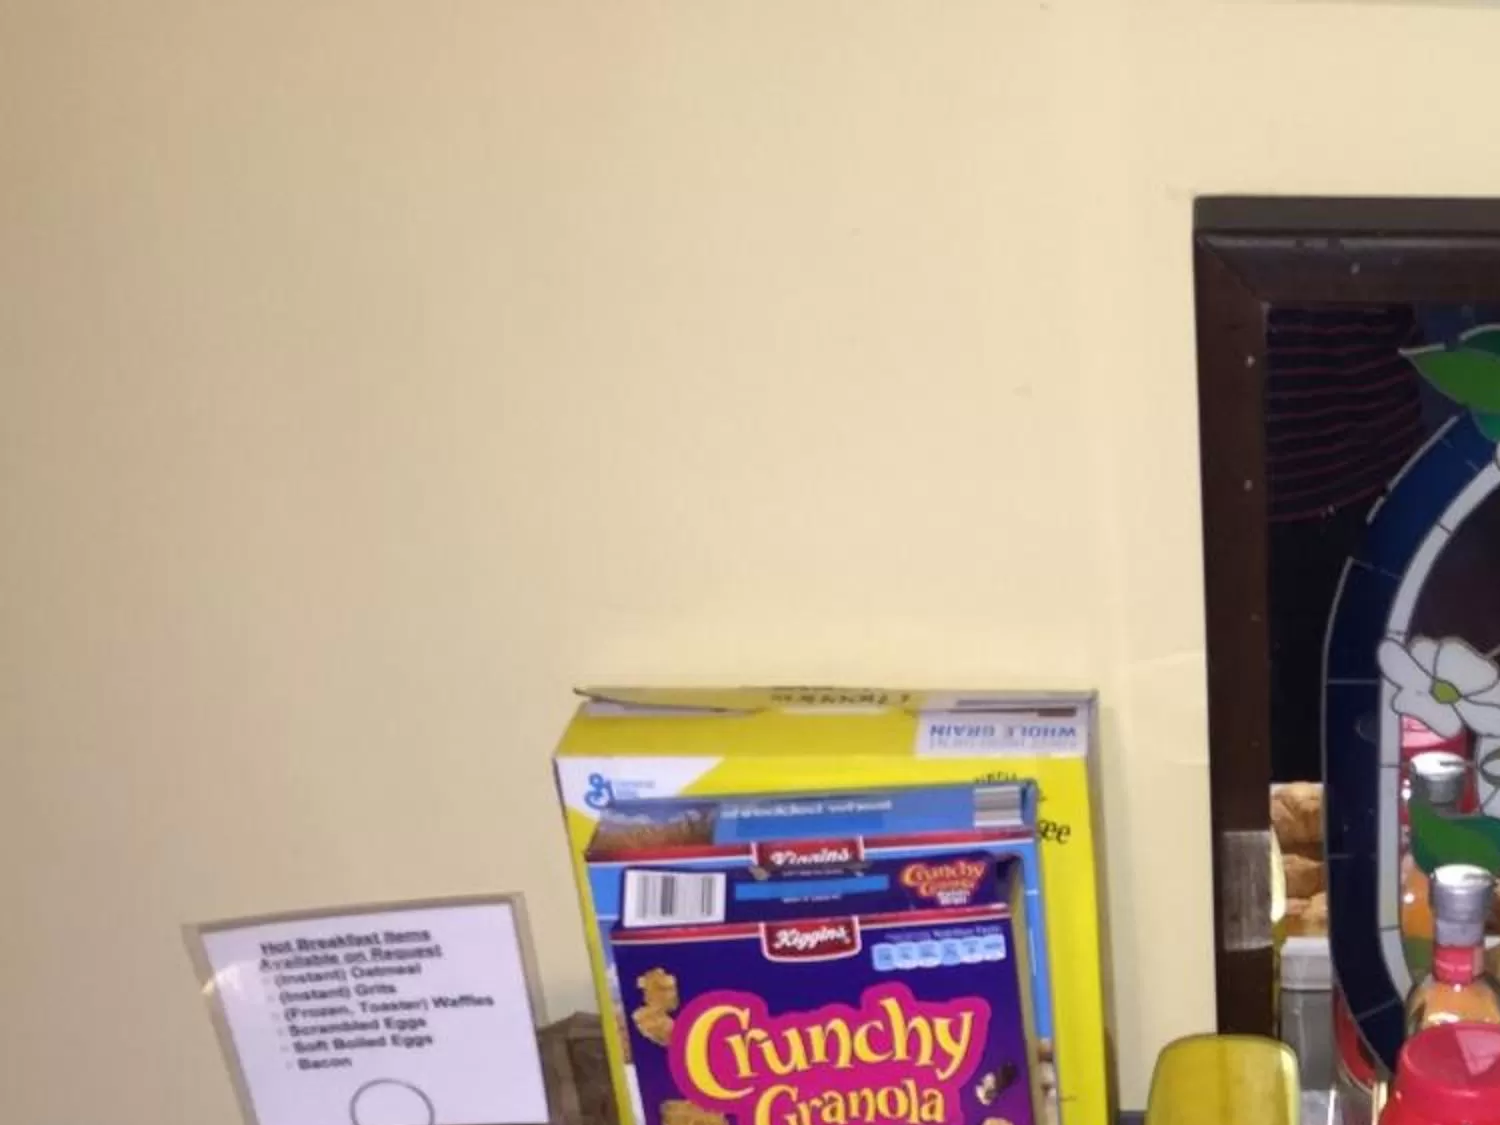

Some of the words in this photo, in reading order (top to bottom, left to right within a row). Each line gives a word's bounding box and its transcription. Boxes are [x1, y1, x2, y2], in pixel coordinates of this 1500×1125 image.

[902, 860, 986, 886] Crunchy
[260, 941, 291, 955] Hot
[296, 931, 381, 951] Breakfast
[383, 930, 431, 944] Items
[773, 925, 847, 950] Kiggins
[259, 954, 340, 972] Available
[344, 951, 367, 963] on
[370, 944, 443, 961] Request
[274, 969, 347, 987] (Instant)
[351, 963, 422, 979] Oatmeal
[279, 987, 351, 1004] (Instant)
[354, 983, 397, 996] Grits
[284, 1005, 354, 1021] (Frozen,
[359, 999, 429, 1013] Toaster)
[431, 994, 494, 1008] Waffles
[288, 1019, 380, 1036] Scrambled
[383, 1016, 427, 1030] Eggs
[293, 1040, 329, 1054] Soft
[333, 1036, 387, 1050] Boiled
[390, 1033, 433, 1048] Eggs
[684, 997, 974, 1100] Crunchy
[297, 1057, 353, 1070] Bacon
